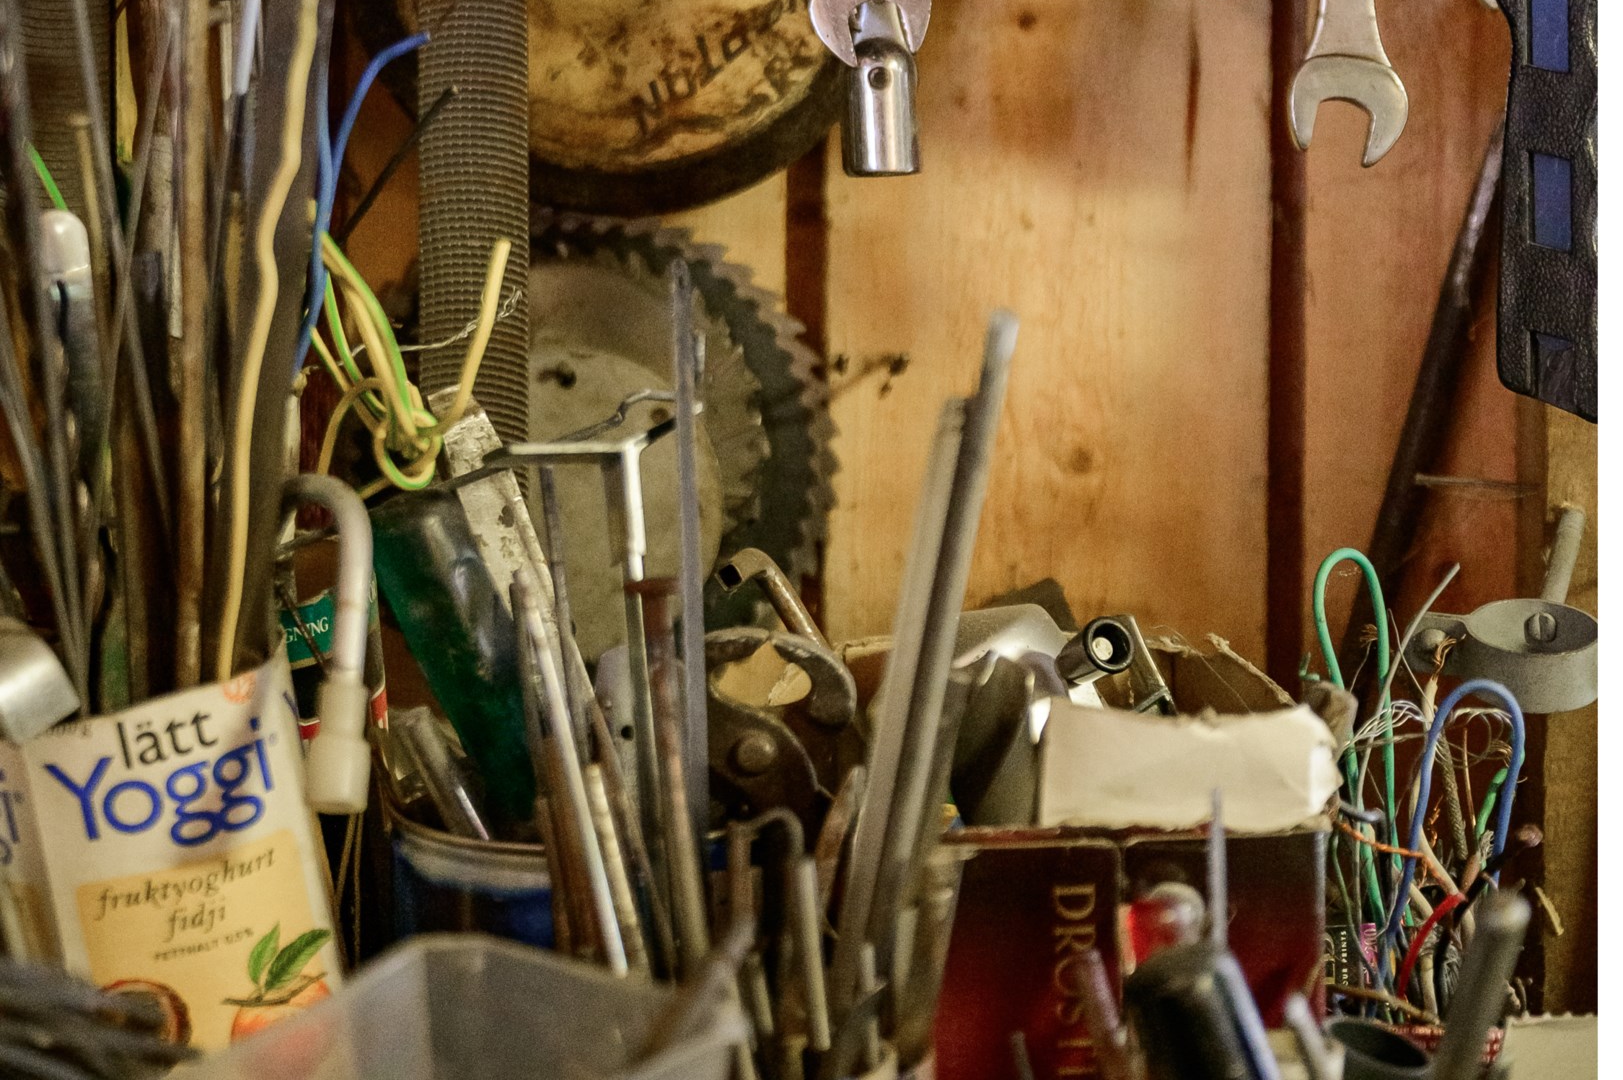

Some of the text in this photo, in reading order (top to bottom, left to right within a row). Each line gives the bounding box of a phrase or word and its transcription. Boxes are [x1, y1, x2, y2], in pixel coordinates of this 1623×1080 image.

[116, 711, 219, 769] lätt
[44, 717, 274, 848] Yoggi
[97, 847, 275, 918] fruktyoghurt
[162, 894, 226, 943] fidji
